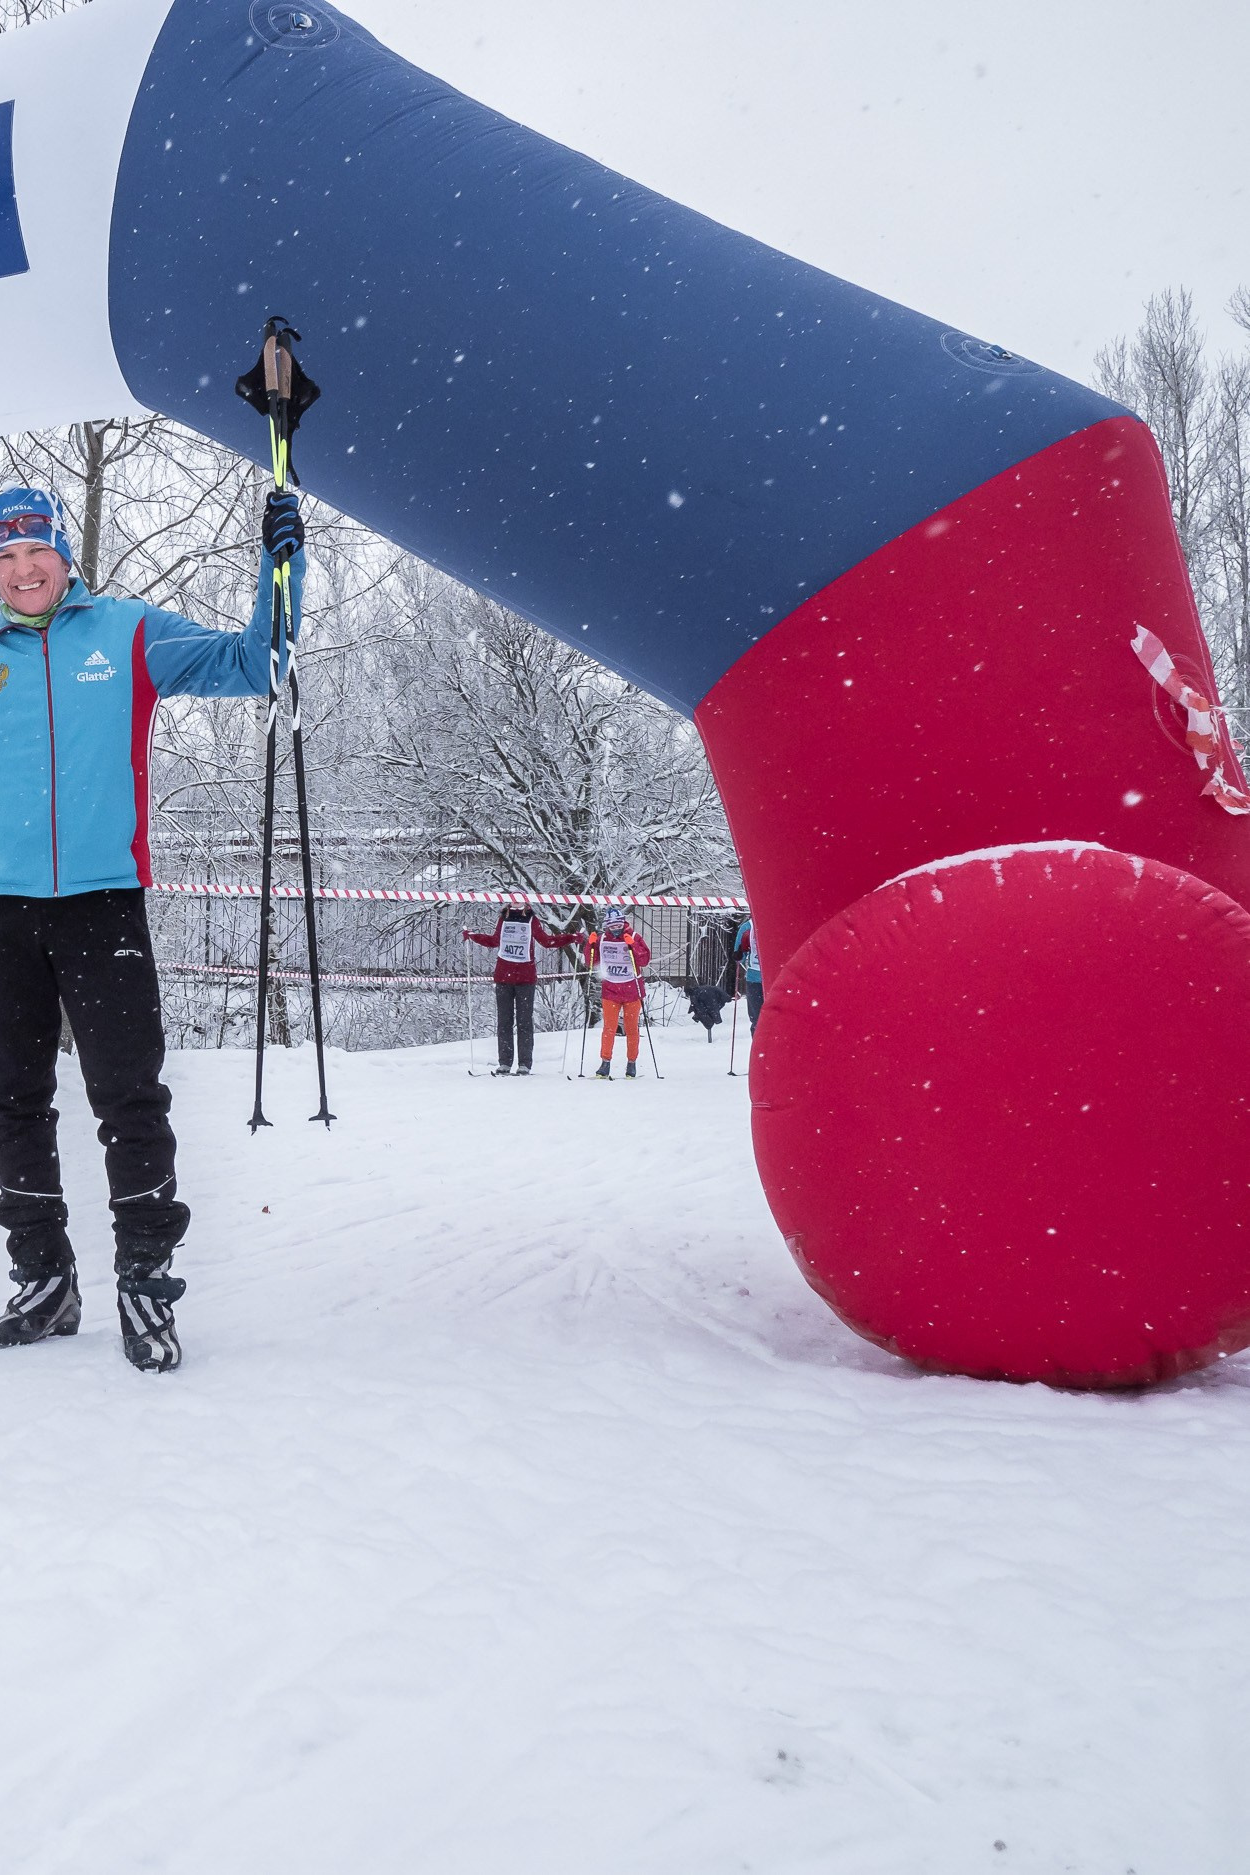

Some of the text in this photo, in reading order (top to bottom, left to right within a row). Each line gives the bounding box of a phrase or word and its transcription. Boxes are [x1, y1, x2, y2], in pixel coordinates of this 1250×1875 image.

[2, 505, 33, 515] RUSSIA
[504, 945, 525, 956] 4072
[607, 965, 629, 975] 4074
